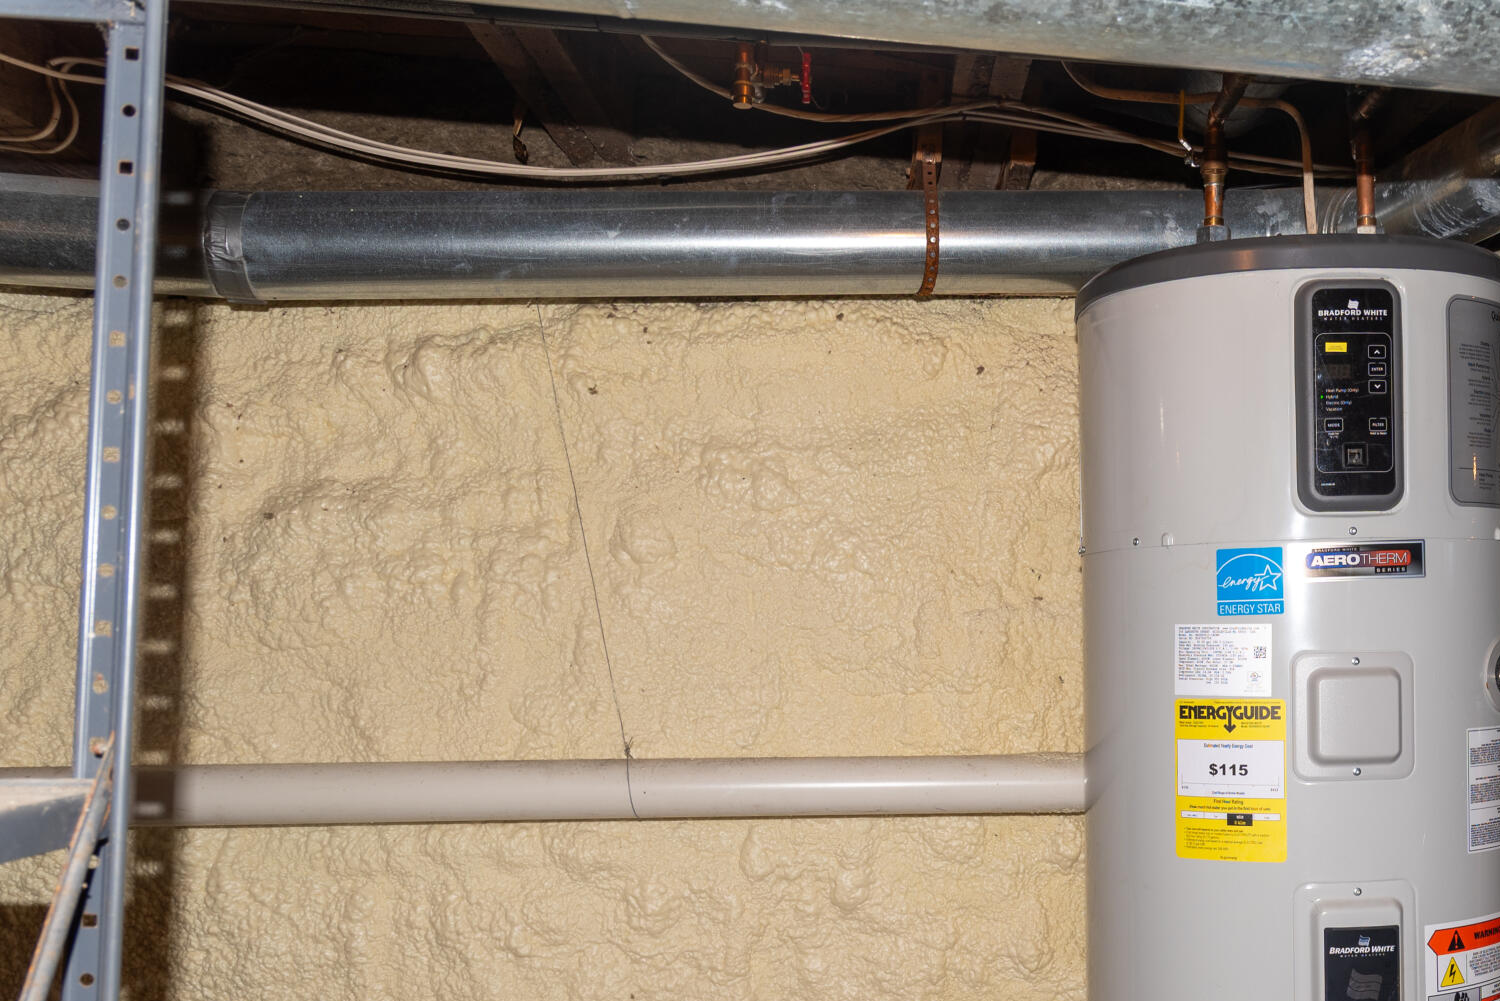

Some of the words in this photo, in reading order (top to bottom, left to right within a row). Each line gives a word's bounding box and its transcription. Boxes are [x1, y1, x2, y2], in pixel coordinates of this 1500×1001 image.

[1318, 309, 1362, 317] BRADFORD
[1310, 551, 1408, 567] AEROTHERM
[1218, 576, 1264, 592] energy
[1219, 604, 1255, 615] ENERGY
[1257, 603, 1281, 613] STAR
[1179, 705, 1282, 721] ENERGYGUIDE
[1209, 763, 1249, 776] $115
[1329, 946, 1371, 955] BRADFORD
[1371, 945, 1396, 953] WHITE
